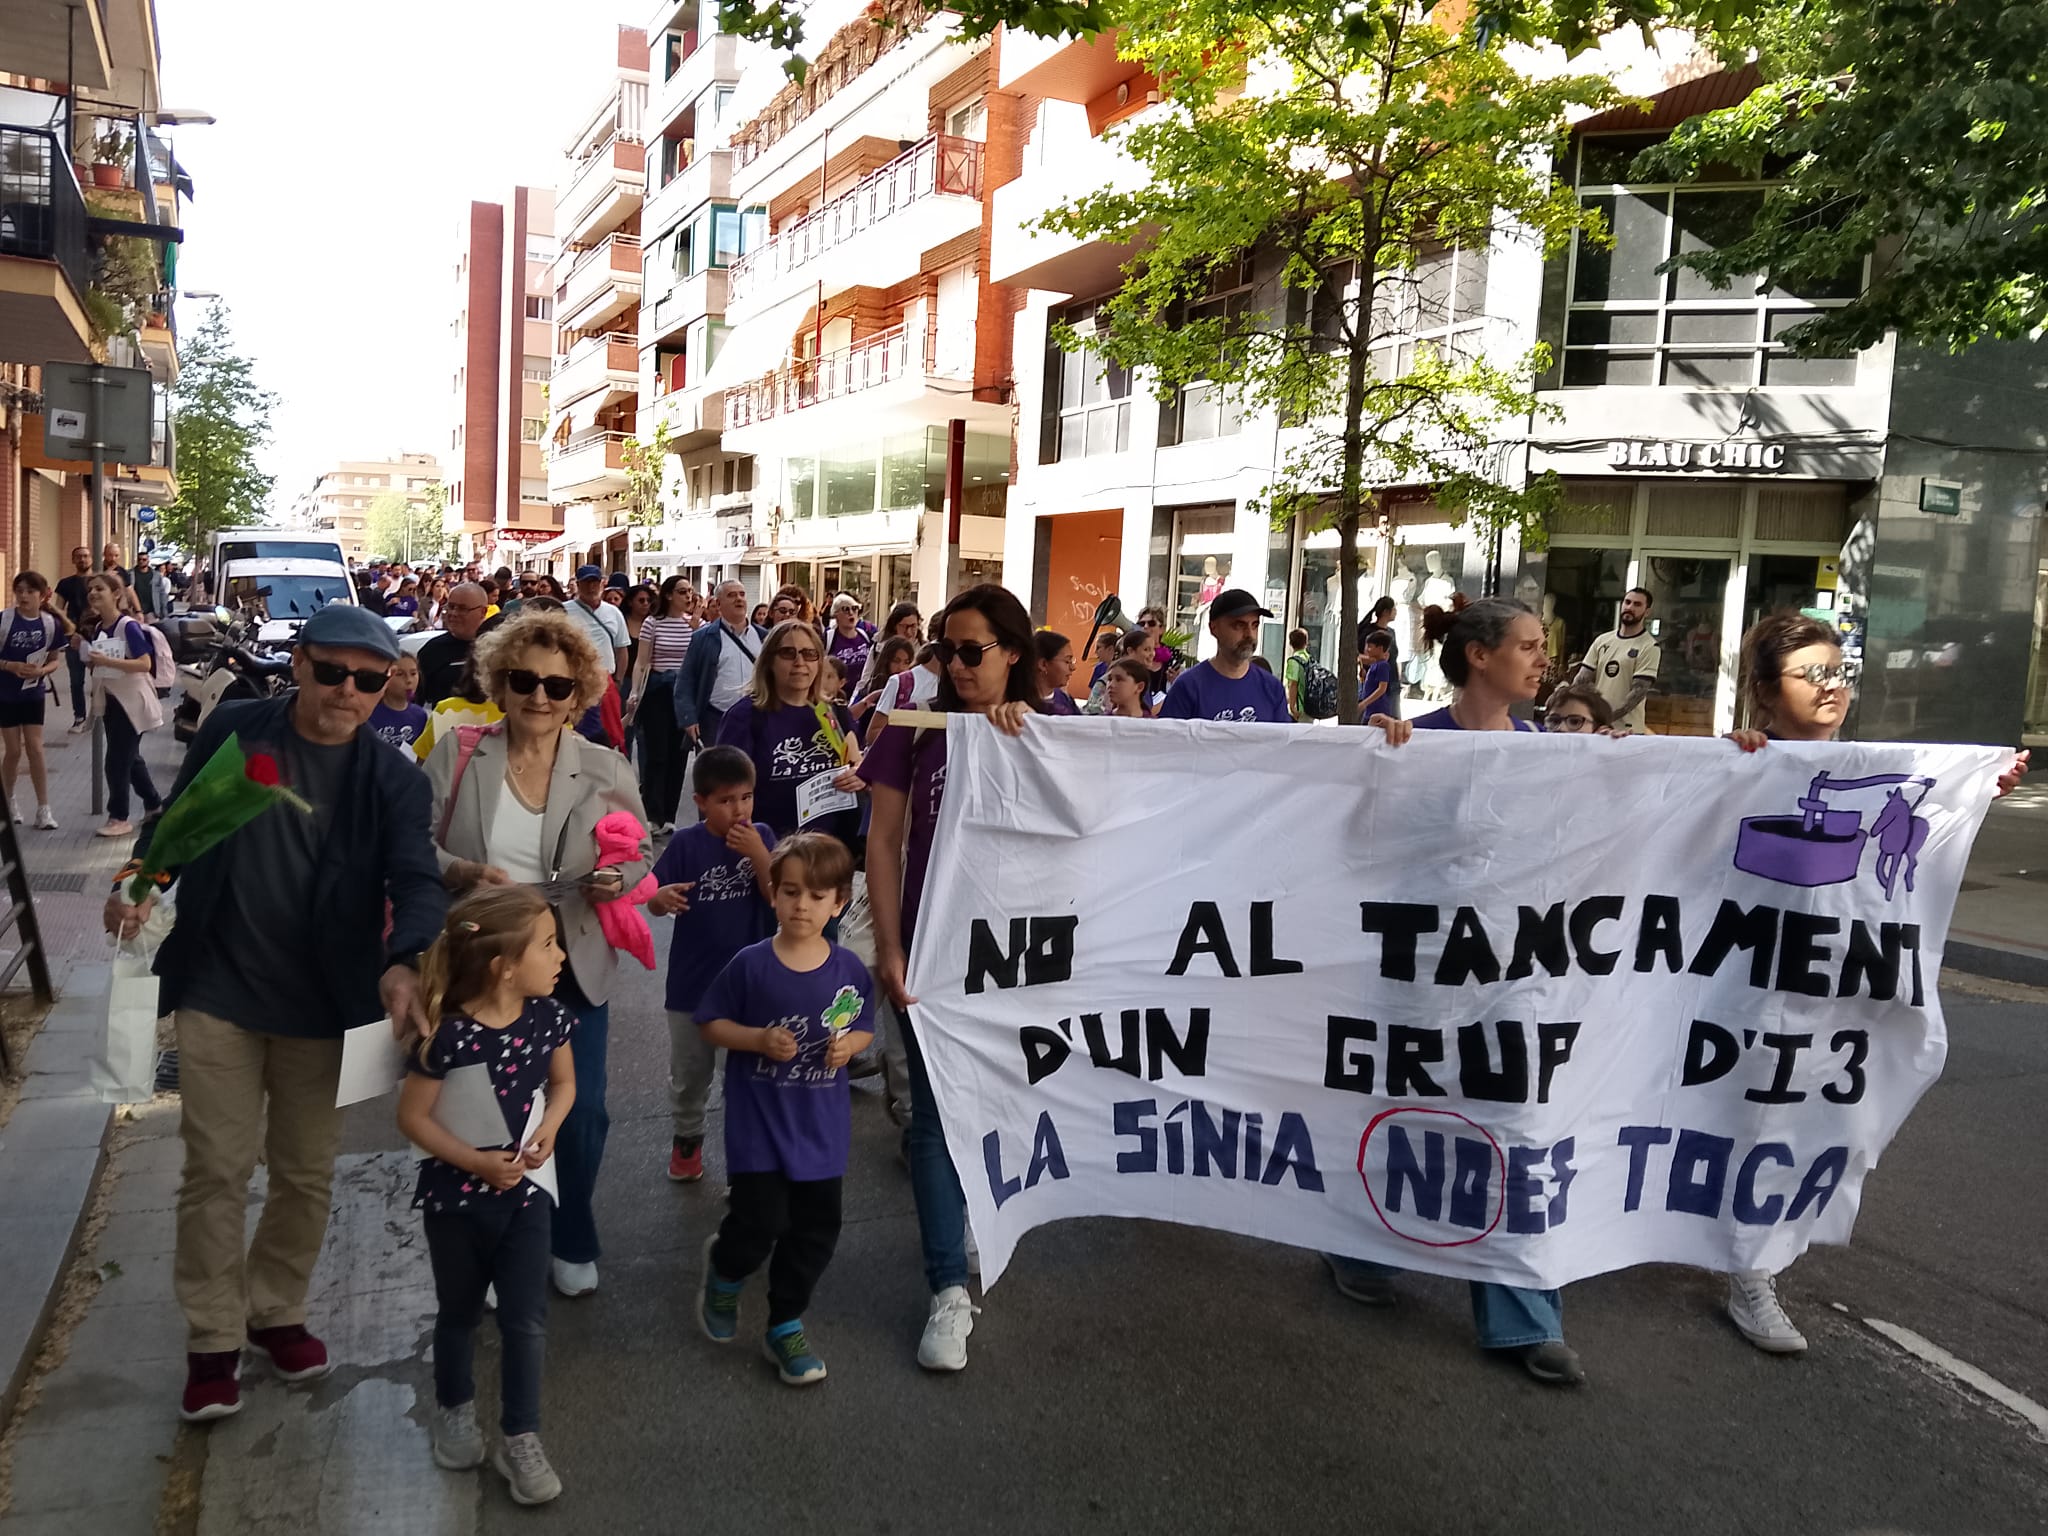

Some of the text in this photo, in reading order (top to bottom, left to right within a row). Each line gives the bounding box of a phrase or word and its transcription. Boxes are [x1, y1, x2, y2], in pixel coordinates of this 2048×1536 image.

[1607, 441, 1786, 470] BLAU CHIC
[771, 766, 792, 776] La
[698, 892, 715, 901] La
[965, 894, 1925, 1007] NO AL TANCAMENT
[756, 1058, 778, 1078] La
[1019, 1007, 1211, 1085] D'UN
[1323, 1015, 1582, 1104] GRUP
[982, 1110, 1071, 1211] LA
[1384, 1125, 1492, 1230] NO
[1506, 1135, 1578, 1235] ES
[1617, 1126, 1849, 1226] TOCA
